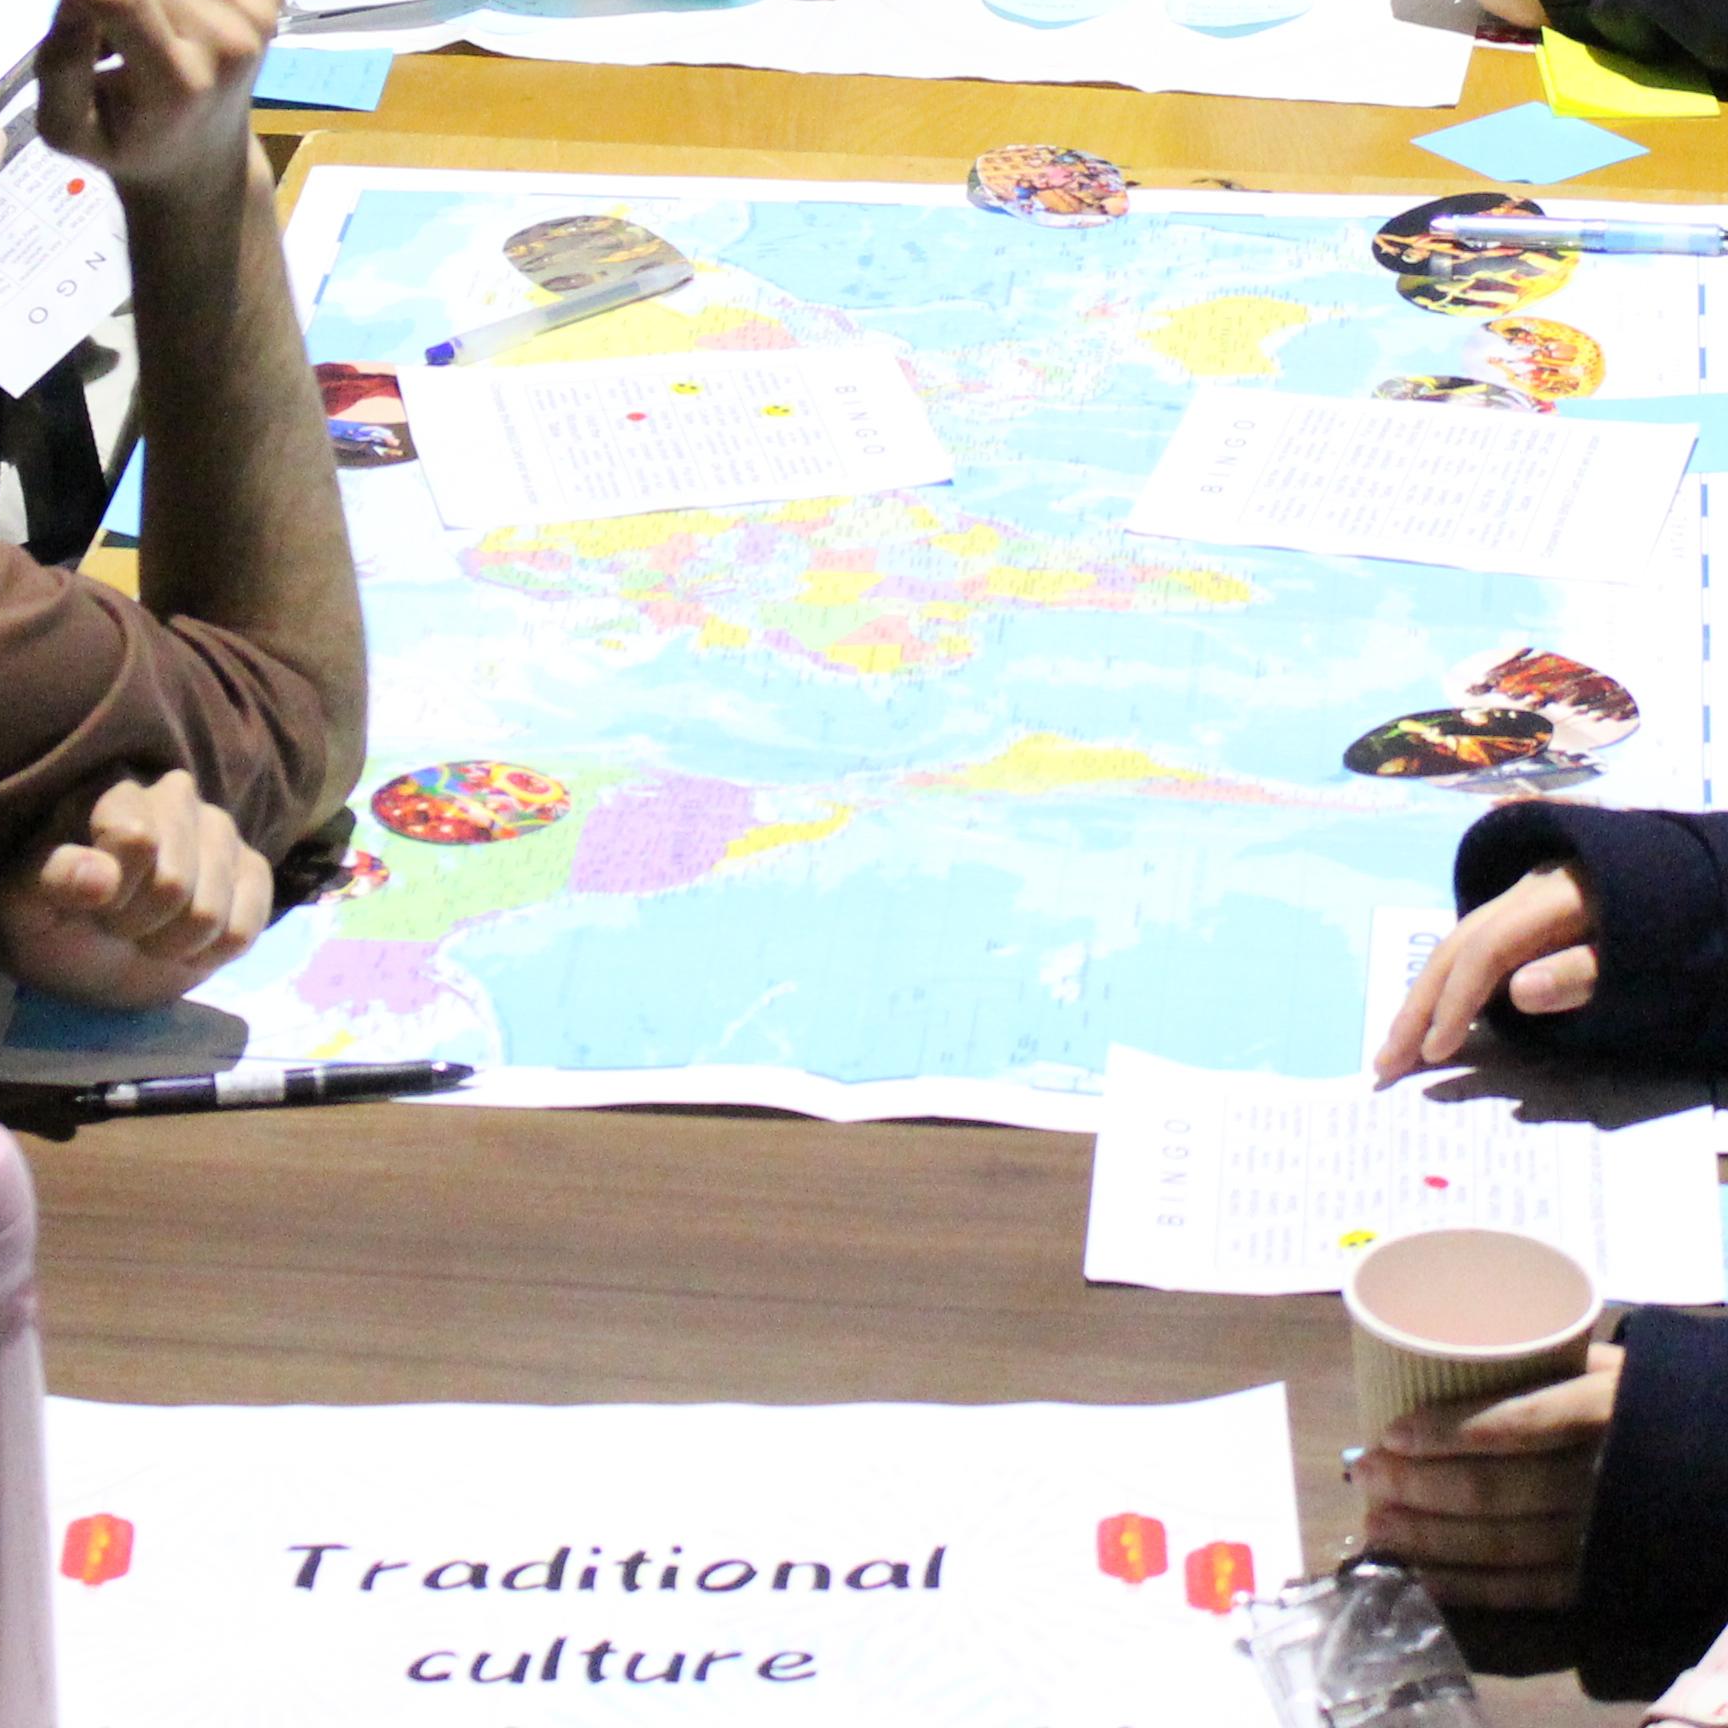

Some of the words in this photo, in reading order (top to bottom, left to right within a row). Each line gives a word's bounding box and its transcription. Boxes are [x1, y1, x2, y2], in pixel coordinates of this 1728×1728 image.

[834, 385, 887, 457] BINGO
[1200, 419, 1256, 495] BINGO
[1155, 1116, 1193, 1228] BINGO
[285, 1541, 948, 1595] Traditional
[408, 1633, 819, 1687] culture
